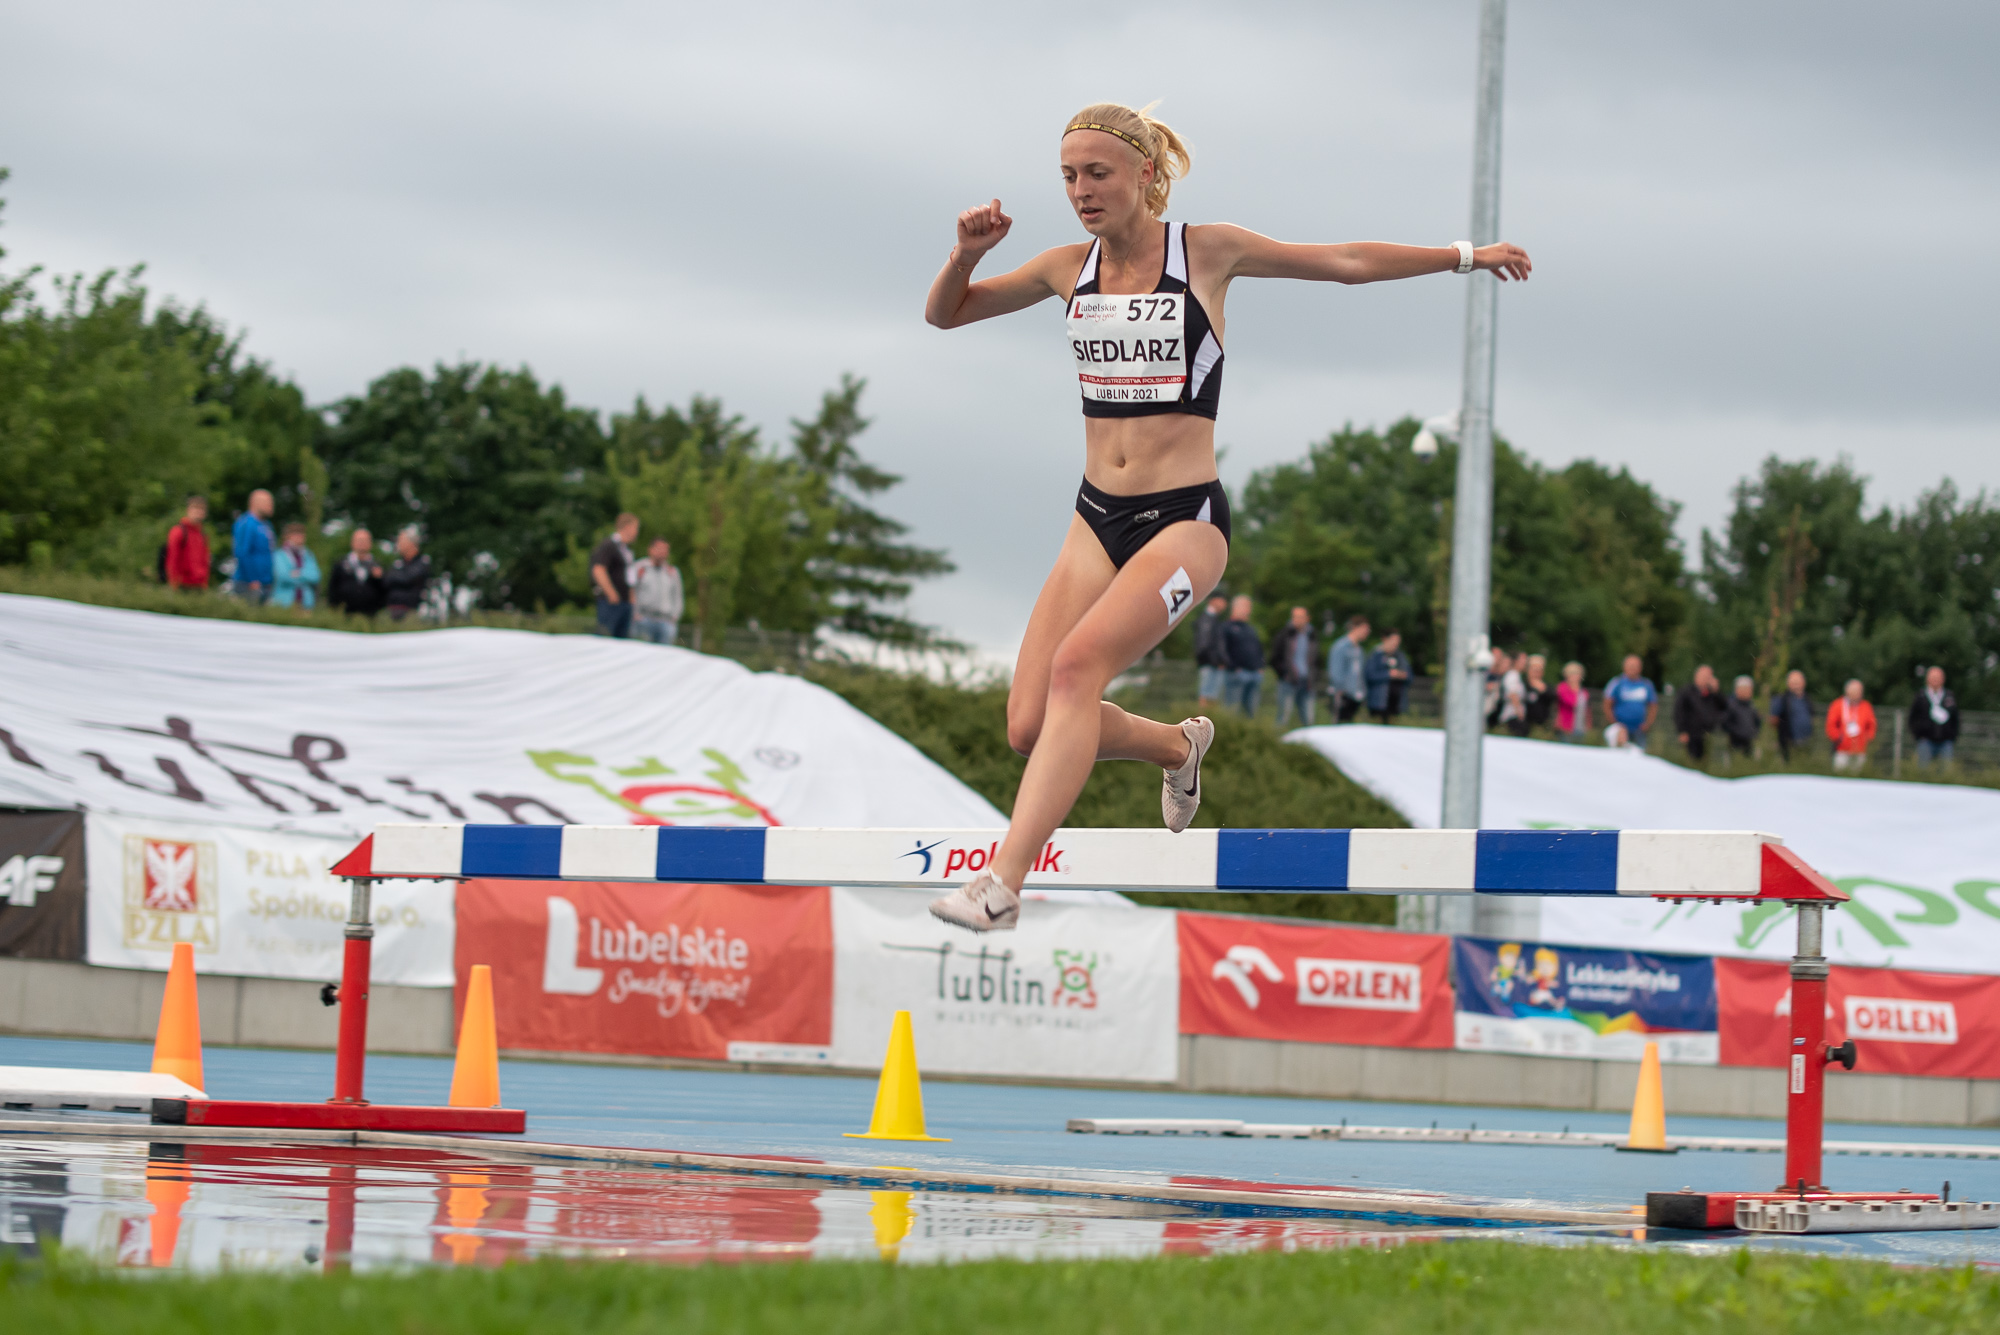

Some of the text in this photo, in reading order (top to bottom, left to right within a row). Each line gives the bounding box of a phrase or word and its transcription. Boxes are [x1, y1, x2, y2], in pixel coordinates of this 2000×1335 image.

[1127, 298, 1176, 322] 572
[1073, 338, 1181, 363] SIEDLARZ
[1096, 388, 1159, 400] LUBLIN 2021
[1170, 589, 1191, 616] 4
[247, 850, 310, 880] PZLA
[943, 840, 1065, 879] polik
[128, 912, 211, 946] PZLA
[1307, 967, 1412, 1001] ORLEN
[1855, 1006, 1949, 1034] ORLEN
